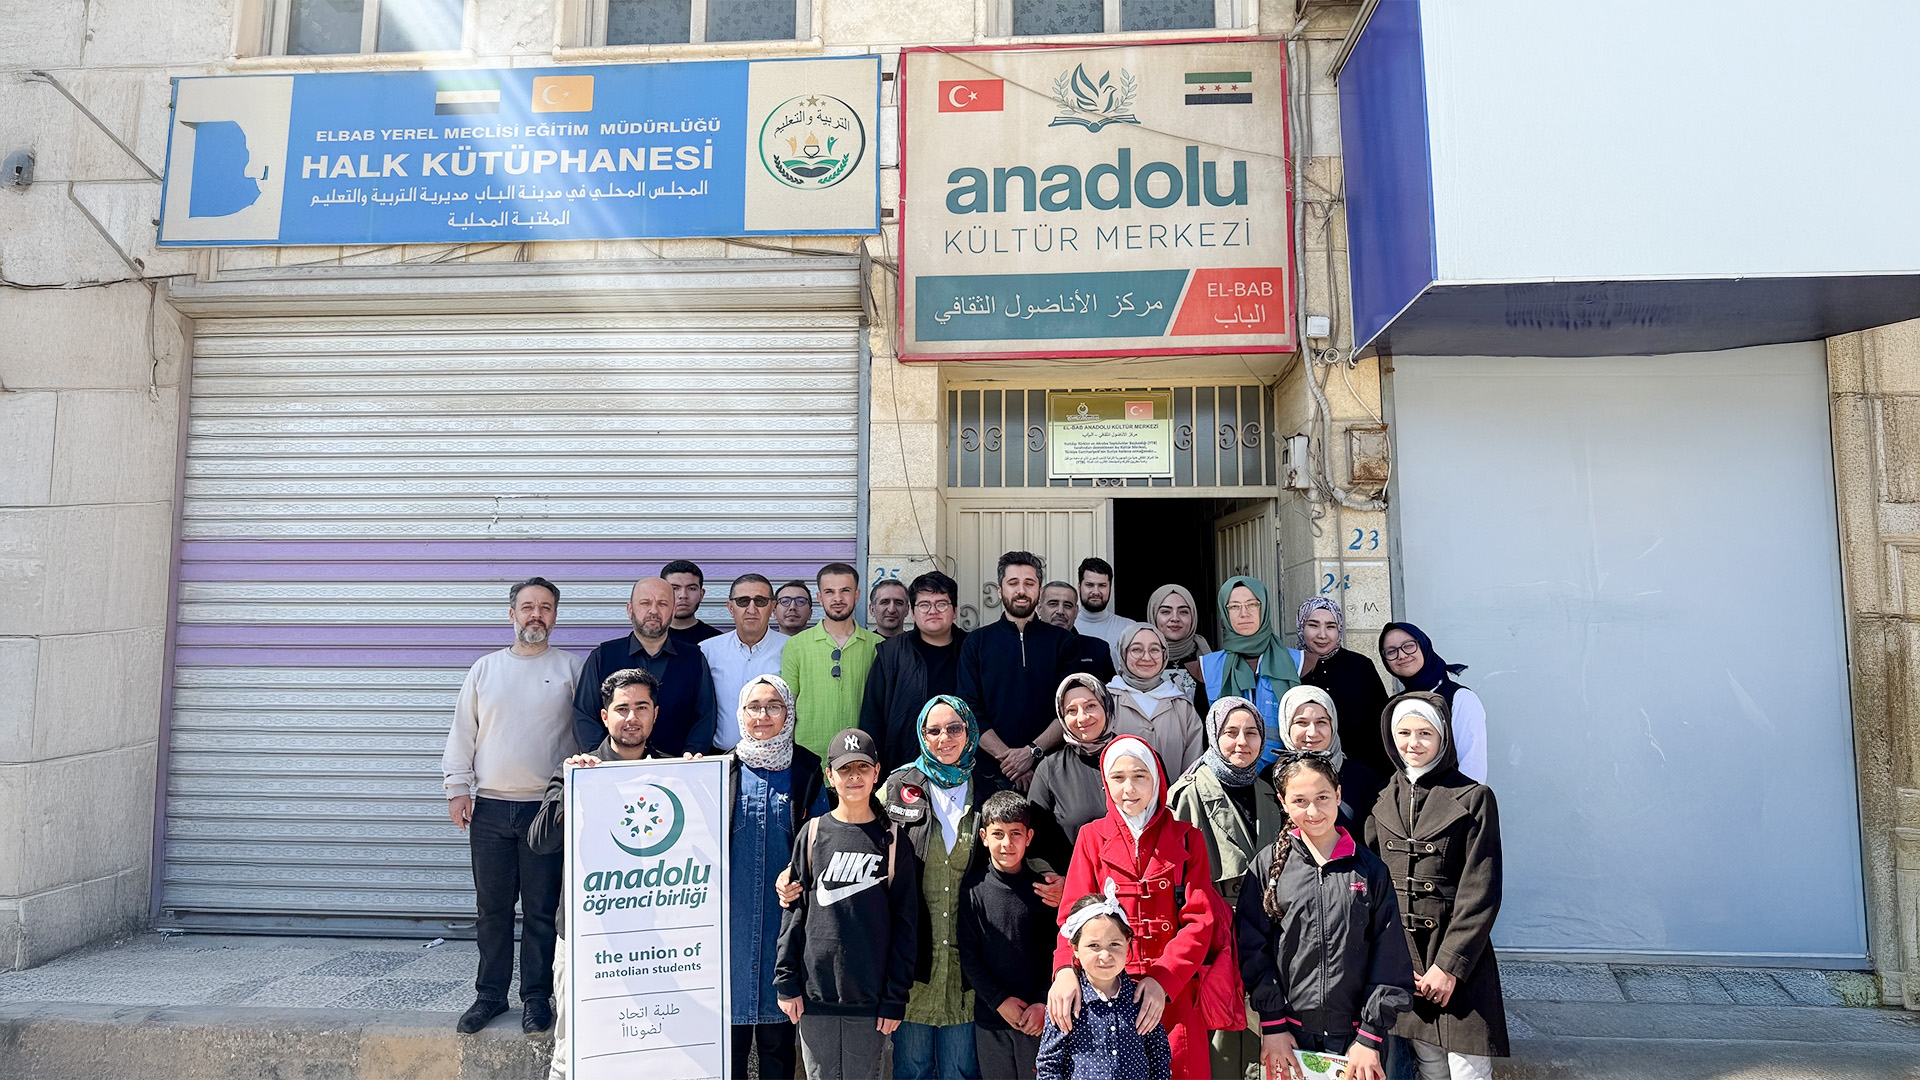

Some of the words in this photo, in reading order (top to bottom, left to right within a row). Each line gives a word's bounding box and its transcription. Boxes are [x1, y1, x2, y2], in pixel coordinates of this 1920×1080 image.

[316, 130, 375, 142] ELBAB
[381, 128, 438, 141] YEREL
[444, 123, 519, 139] MECLİSİ
[524, 122, 589, 138] EĞİTİM
[600, 117, 721, 135] MÜDÜRLÜĞÜ
[816, 109, 850, 131] التربية
[301, 153, 410, 179] HALK
[421, 138, 713, 178] KÜTÜPHANESİ
[648, 180, 709, 200] المجلس
[945, 145, 1248, 215] anadolu
[310, 187, 367, 207] والتعليم
[371, 187, 417, 206] التربية
[420, 186, 469, 205] مديرية
[474, 185, 515, 204] الباب
[518, 184, 562, 203] مدينة
[565, 184, 586, 202] في
[589, 181, 646, 202] المحلي
[447, 211, 509, 230] المحلية
[511, 209, 570, 230] المكتبة
[944, 225, 1078, 254] KÜLTÜR
[1096, 218, 1251, 251] MERKEZİ
[1207, 281, 1273, 298] EL-BAB
[934, 294, 996, 325] الثقافي
[1004, 288, 1097, 320] الأناضول
[1107, 291, 1163, 319] مركز
[1214, 304, 1266, 329] الباب
[1348, 528, 1379, 551] 23
[844, 735, 860, 750] NY
[583, 858, 711, 892] anadolu
[823, 852, 884, 883] NIKE
[583, 890, 653, 915] öğrenci
[655, 887, 708, 908] birliği
[594, 950, 623, 964] the
[629, 946, 677, 961] union
[683, 942, 701, 957] of
[594, 966, 649, 978] anatolian
[652, 962, 701, 974] students
[618, 1006, 648, 1020] اتحاد
[653, 1003, 680, 1020] طلبة
